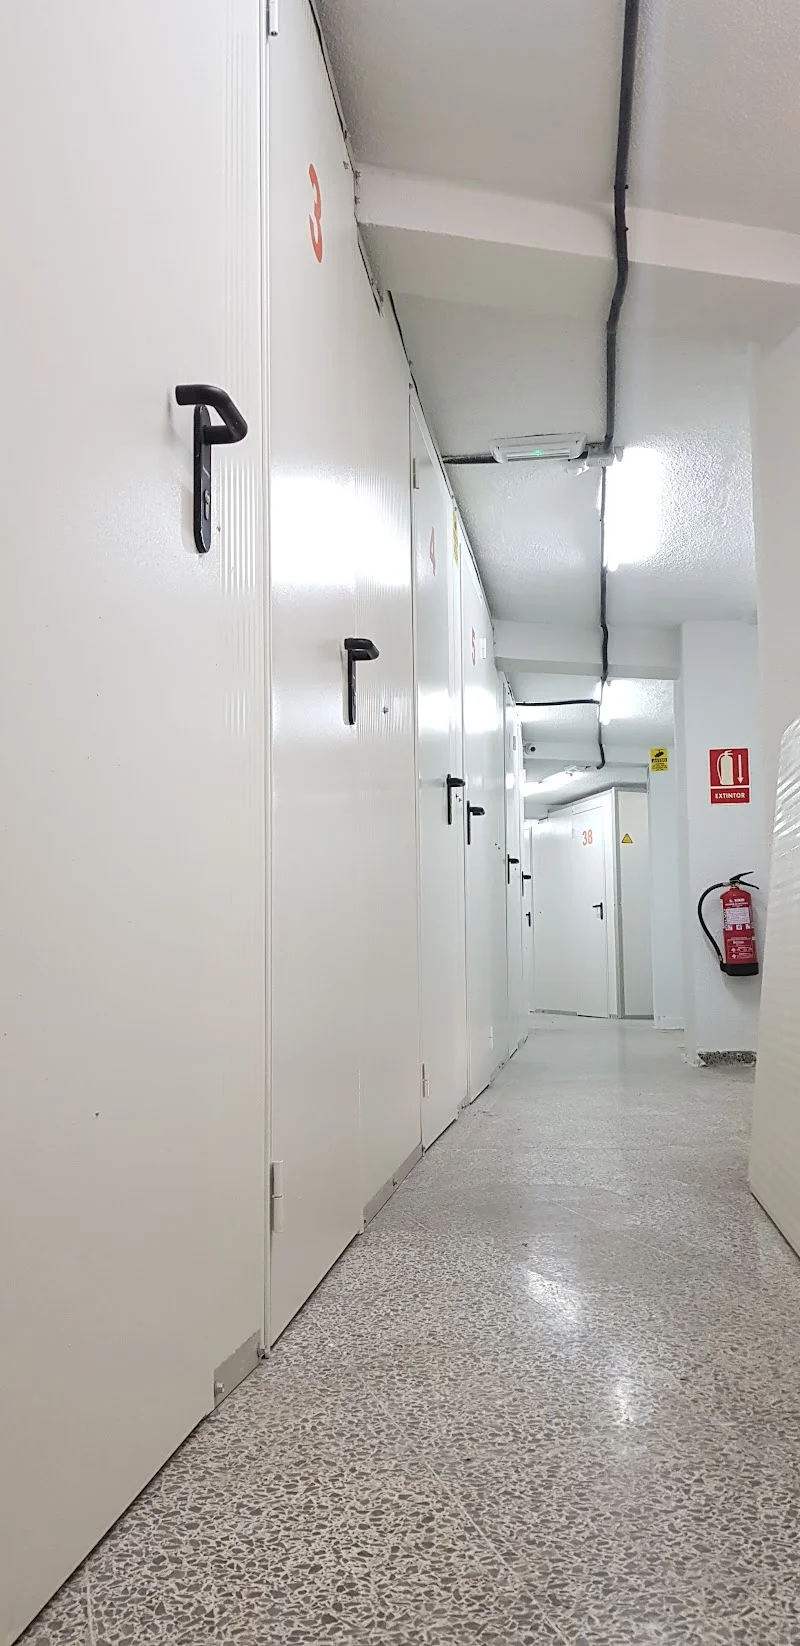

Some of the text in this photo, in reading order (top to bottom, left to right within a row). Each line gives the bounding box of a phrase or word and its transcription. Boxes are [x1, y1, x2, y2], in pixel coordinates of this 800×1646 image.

[309, 163, 322, 263] 3
[430, 526, 436, 577] 4
[471, 626, 476, 667] 5
[582, 829, 593, 846] 38
